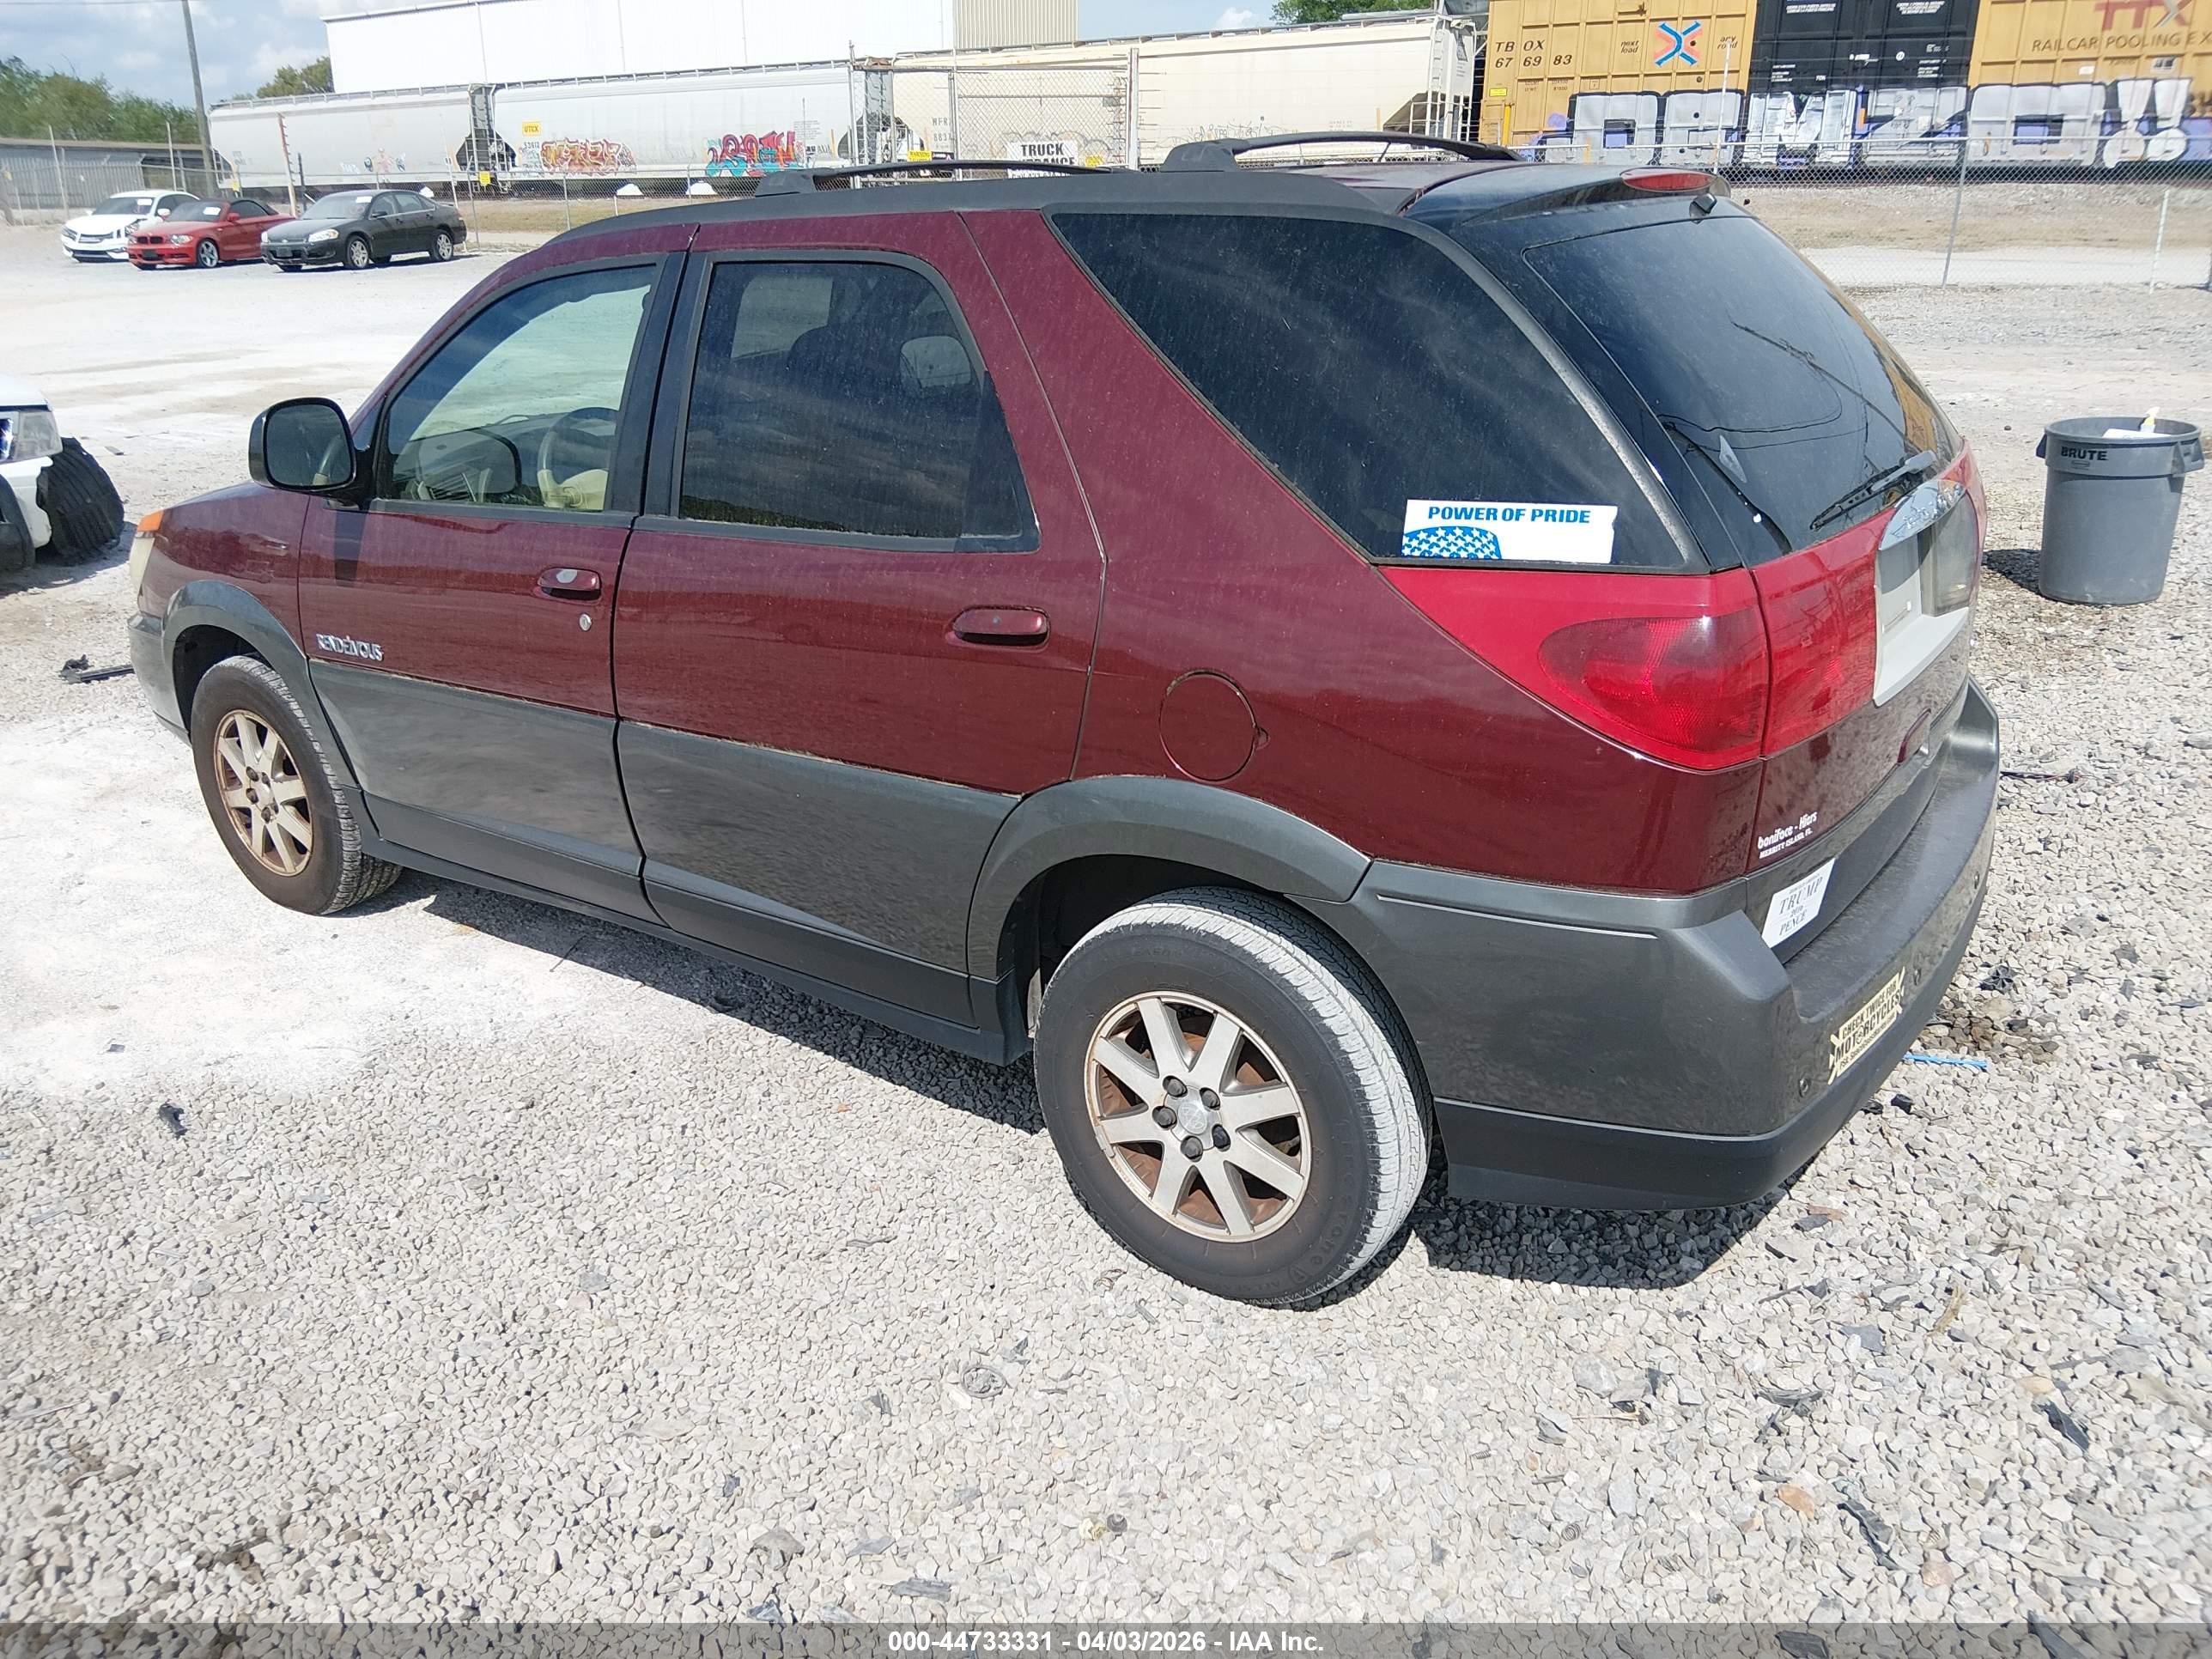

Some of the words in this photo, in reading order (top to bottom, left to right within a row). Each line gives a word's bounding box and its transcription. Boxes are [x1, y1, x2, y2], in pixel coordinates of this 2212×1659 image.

[1495, 41, 1515, 52] TB
[1523, 40, 1546, 52] OX
[1620, 45, 1638, 54] load
[1717, 40, 1738, 49] rod
[2032, 36, 2098, 52] RAILCAR
[2106, 33, 2180, 49] POOLING
[1495, 57, 1513, 69] 67
[1523, 56, 1542, 67] 69
[1553, 54, 1572, 66] 83
[1021, 143, 1064, 156] TRUCK
[2061, 446, 2108, 461] BRUTE
[1428, 506, 1498, 521] POWER
[1502, 507, 1527, 521] OF
[1531, 508, 1591, 524] PRIDE
[1779, 876, 1823, 915] TRUMP
[1779, 909, 1808, 936] PENCE
[1842, 1012, 1865, 1039] CHECK
[1866, 993, 1886, 1018] TWICE
[1886, 981, 1897, 996] FOR
